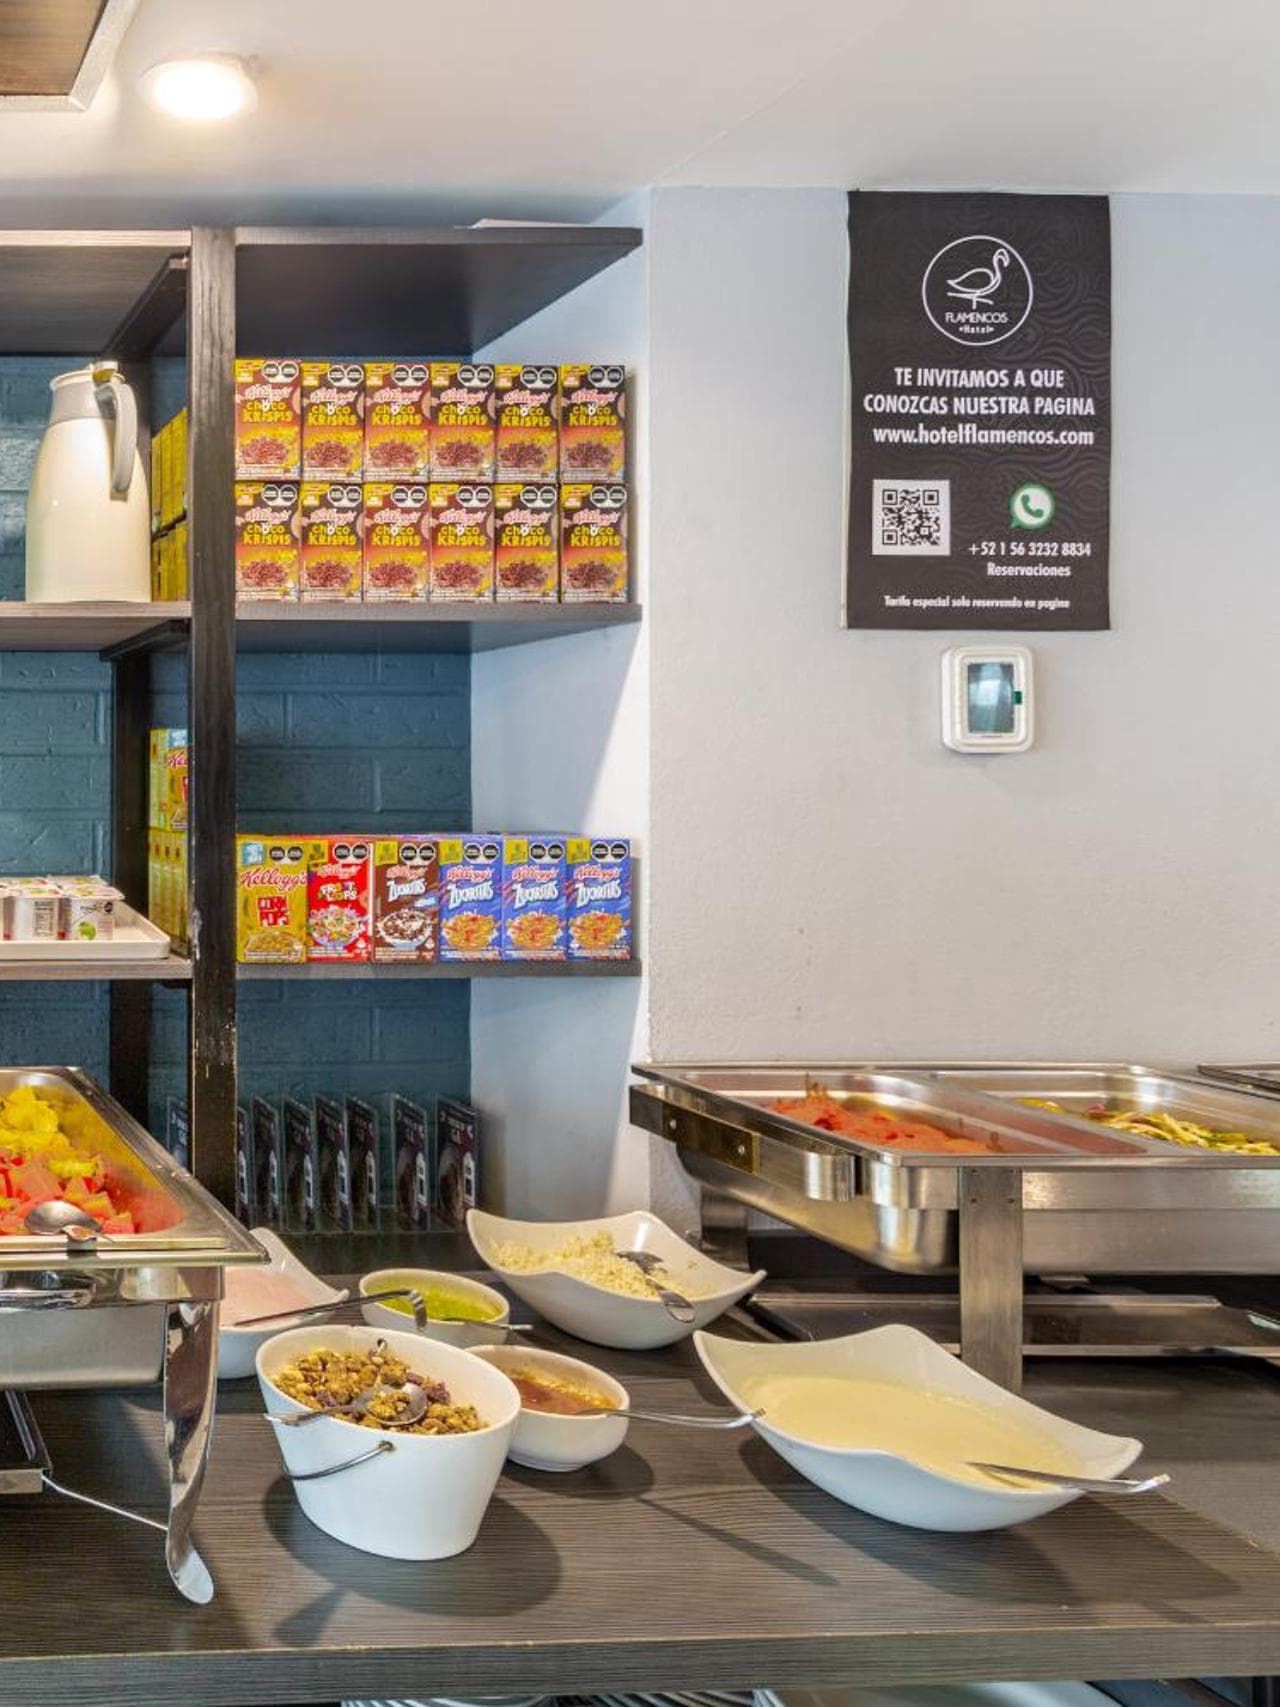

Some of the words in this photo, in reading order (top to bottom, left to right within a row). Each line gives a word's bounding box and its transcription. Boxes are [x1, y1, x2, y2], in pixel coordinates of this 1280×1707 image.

[945, 311, 1008, 323] FLAMENCOS
[894, 367, 912, 386] TE
[917, 368, 1009, 388] INVITAMOS
[1013, 369, 1026, 388] A
[1030, 369, 1064, 388] QUE
[863, 394, 948, 414] CONOZCAS
[953, 396, 1030, 415] NUESTRA
[1034, 397, 1095, 415] PAGINA
[873, 423, 1094, 445] www.hotelflamencos.com
[968, 541, 996, 556] +52
[1000, 541, 1006, 556] 1
[1010, 542, 1025, 556] 56
[1028, 542, 1059, 556] 3232
[1061, 542, 1091, 557] 8834
[987, 561, 1071, 577] Reservaciones
[913, 595, 950, 610] especial
[240, 866, 307, 891] Kellogg's
